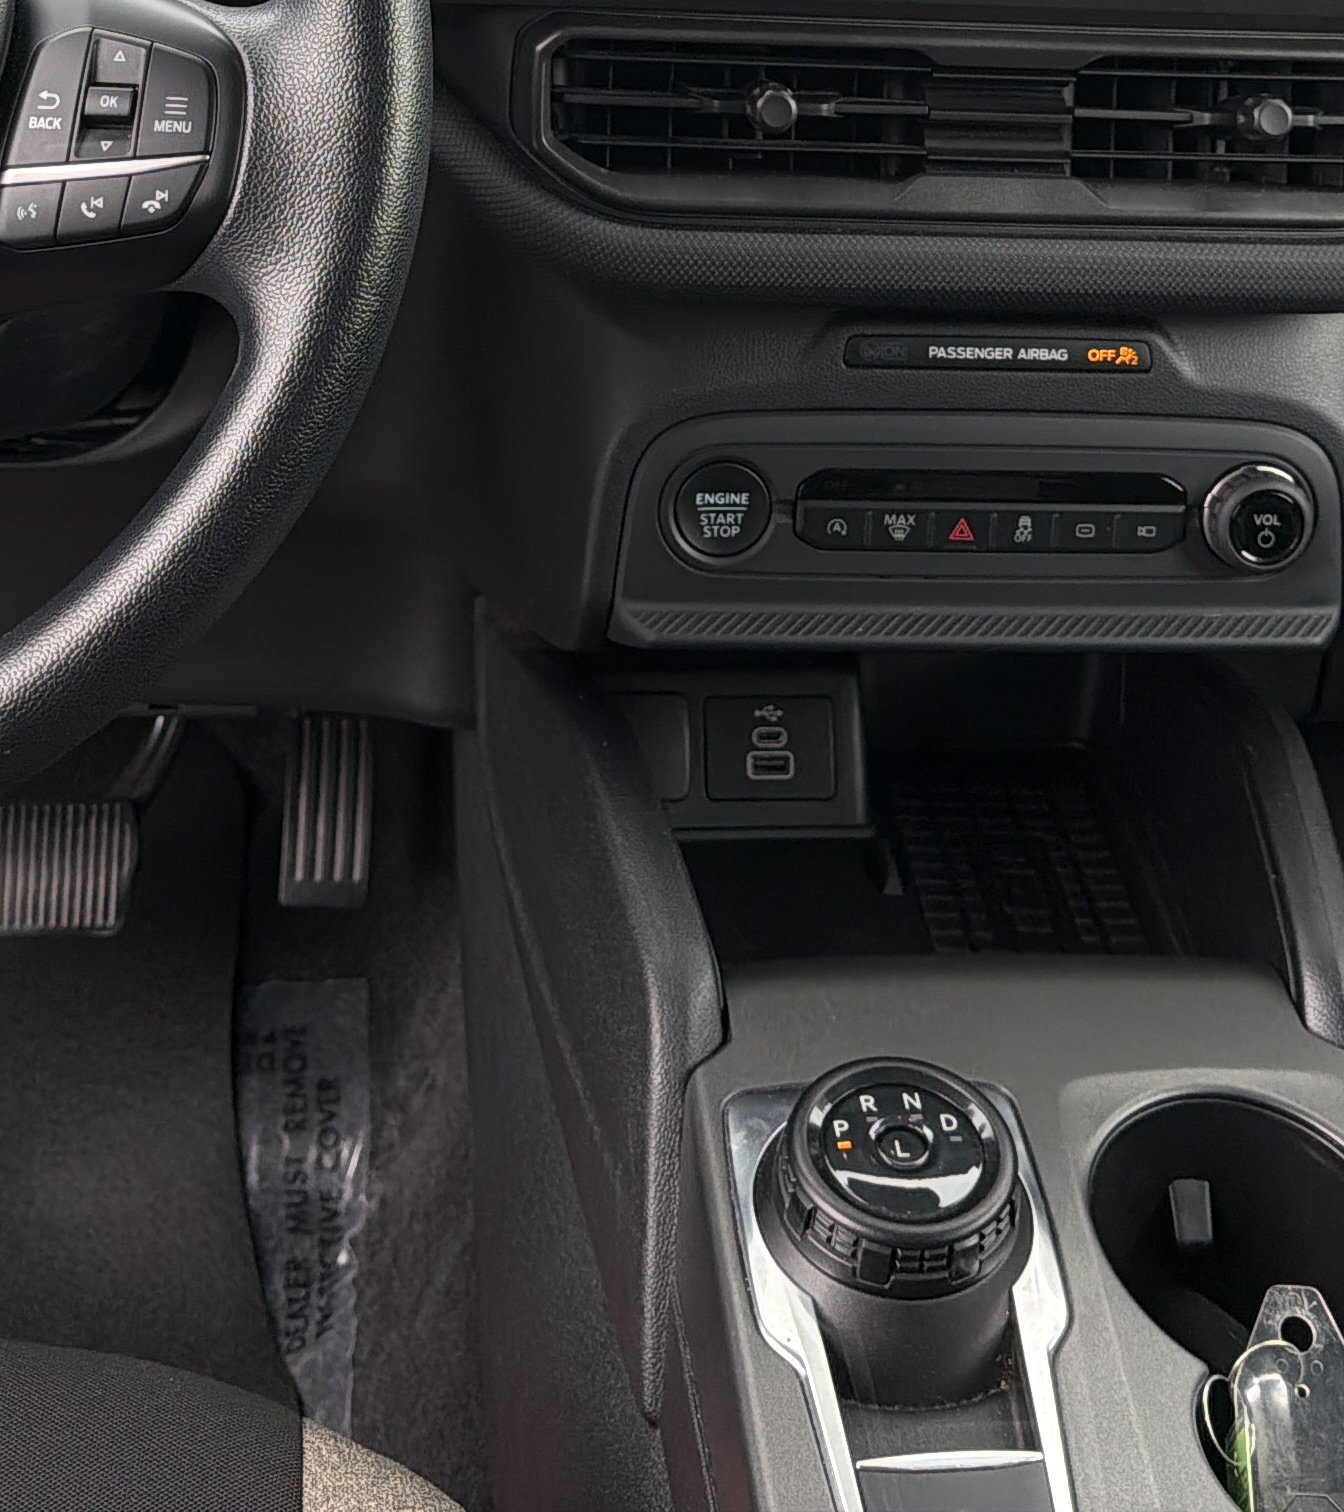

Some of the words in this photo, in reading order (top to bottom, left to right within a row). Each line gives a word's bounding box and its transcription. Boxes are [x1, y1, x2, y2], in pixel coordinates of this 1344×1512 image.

[99, 96, 118, 109] OK
[28, 116, 64, 131] BACK
[153, 120, 193, 134] MENU
[928, 345, 1013, 361] PASSENGER
[1017, 347, 1069, 362] AIRBAG
[1087, 348, 1117, 363] OFF
[695, 492, 750, 506] ENGINE
[699, 512, 744, 526] START
[883, 513, 917, 526] MAX
[1253, 513, 1282, 527] VOL
[702, 525, 742, 538] STOP
[1013, 533, 1033, 543] OFF
[281, 1026, 310, 1132] REMOVE
[859, 1094, 878, 1113] R
[902, 1091, 924, 1111] N
[832, 1119, 850, 1137] P
[939, 1113, 958, 1132] D
[894, 1139, 911, 1158] L
[283, 1155, 312, 1235] MUST
